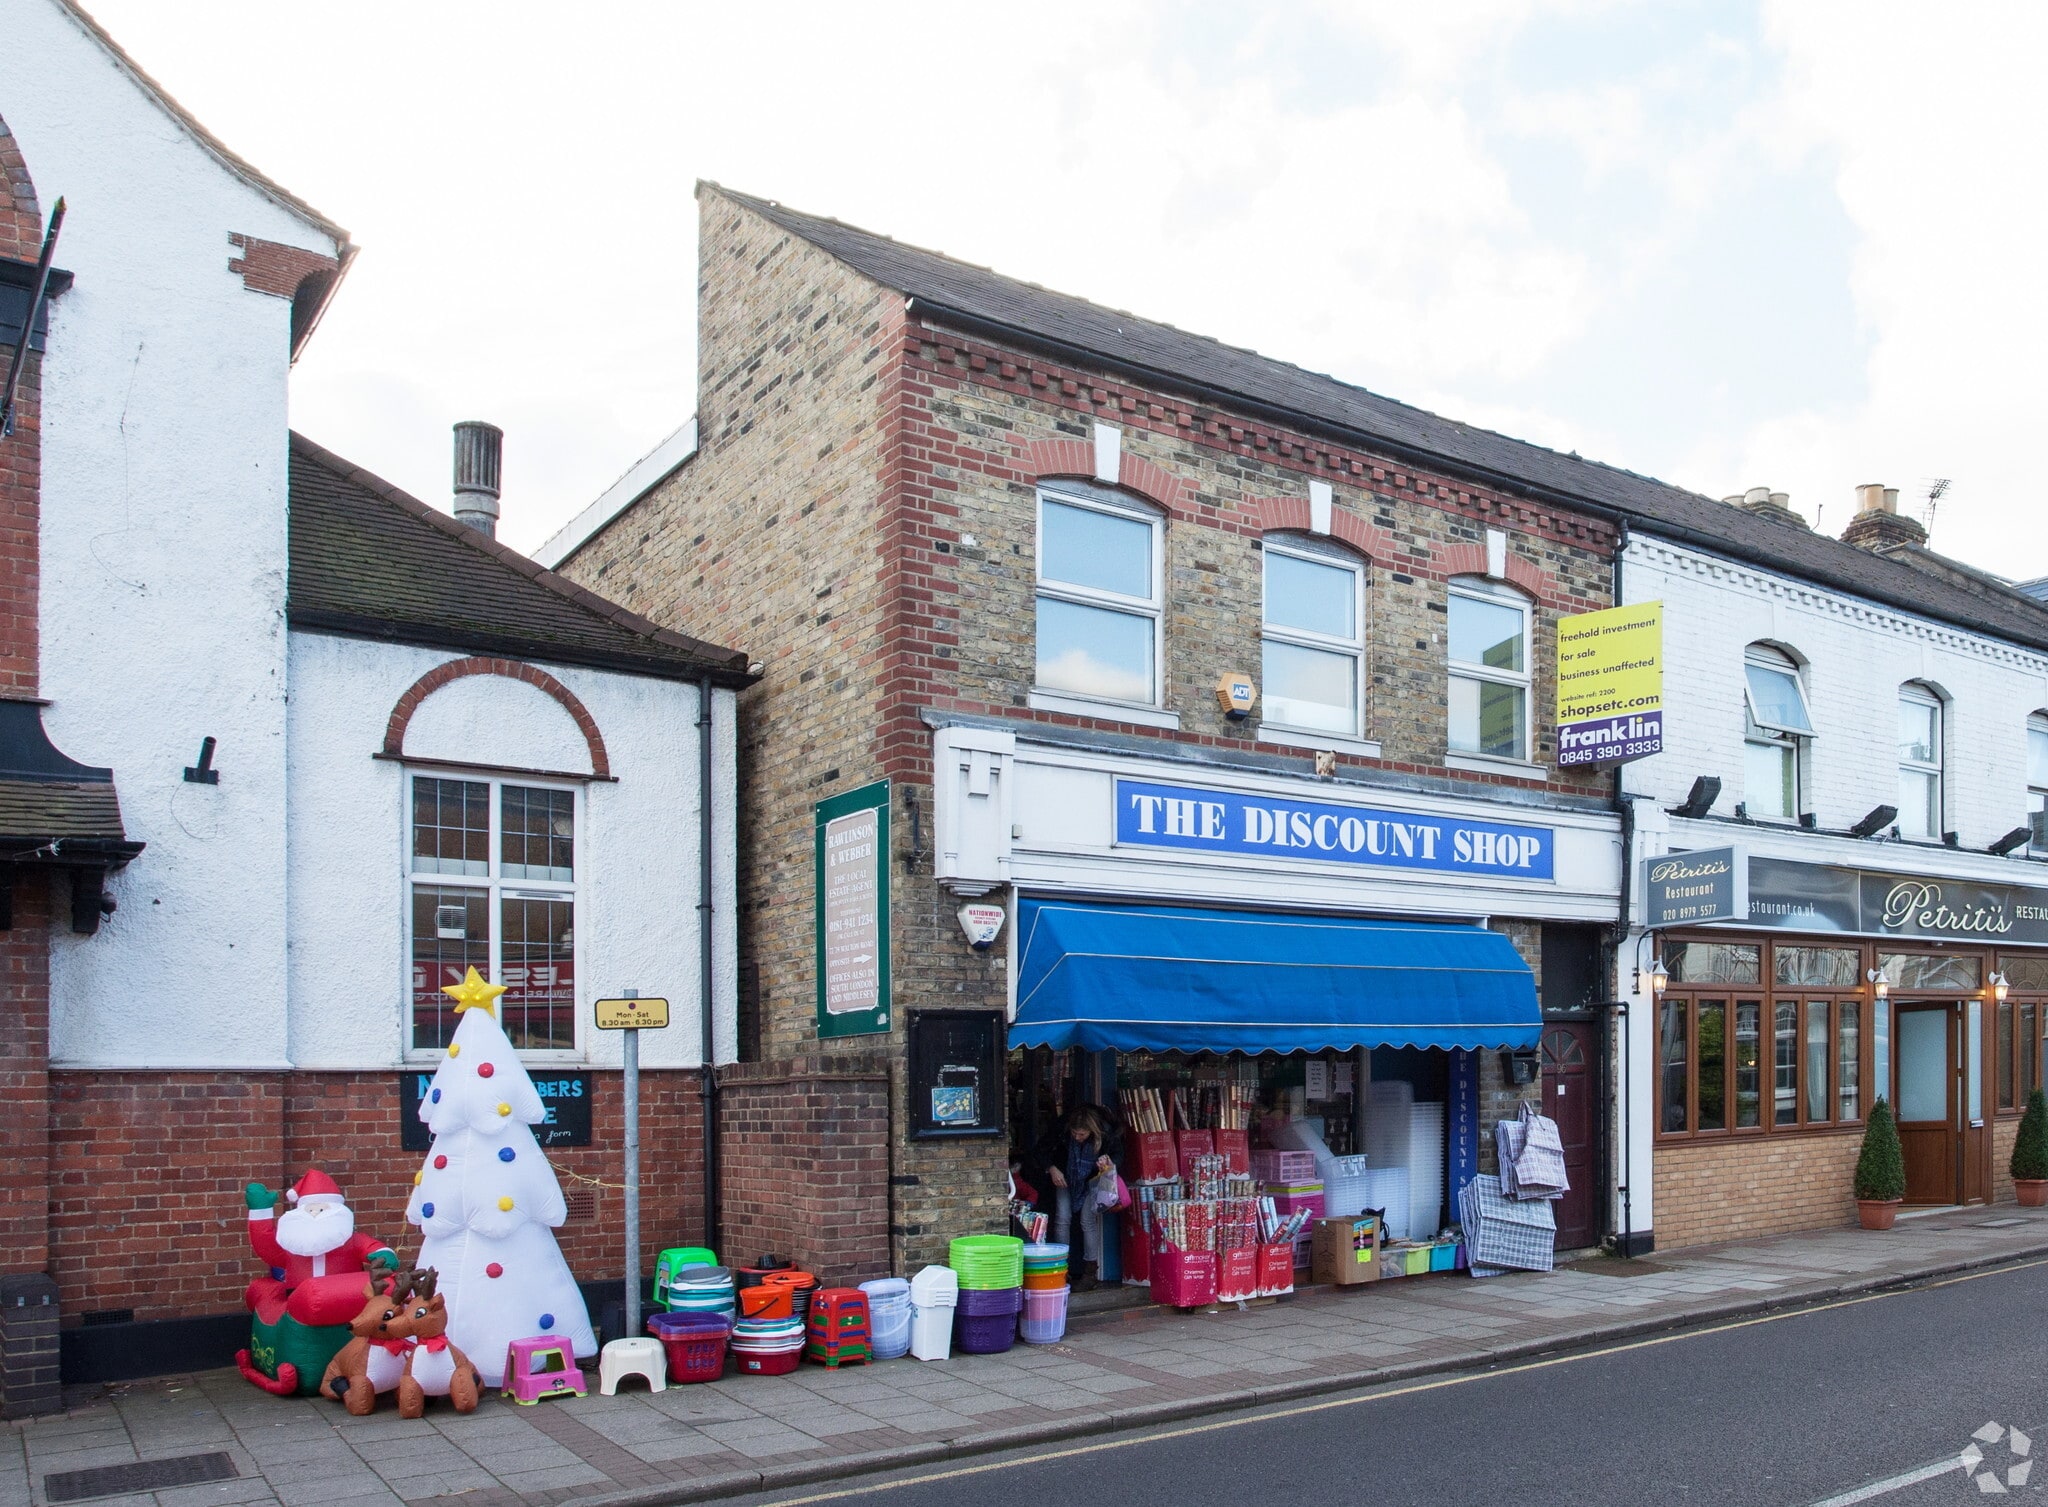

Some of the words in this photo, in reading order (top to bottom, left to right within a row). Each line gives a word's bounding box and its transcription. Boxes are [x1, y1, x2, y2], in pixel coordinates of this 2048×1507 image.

[1560, 627, 1600, 642] freehold
[1602, 618, 1655, 635] investment
[1561, 653, 1573, 662] for
[1577, 648, 1596, 659] sale
[1560, 669, 1600, 681] business
[1602, 656, 1655, 674] unaffected
[1233, 685, 1250, 699] ADT
[1561, 694, 1584, 703] website
[1599, 688, 1616, 696] 2200
[1560, 695, 1659, 718] shopsetc.com
[1560, 716, 1660, 750] franklin
[1560, 749, 1592, 764] 0845
[1596, 745, 1622, 759] 390
[1626, 740, 1660, 755] 3333
[829, 822, 874, 848] RAWLINSON
[1131, 793, 1226, 840] THE
[1243, 805, 1440, 861] DISCOUNT
[1453, 829, 1540, 868] SHOP
[830, 854, 836, 867] &
[838, 842, 872, 864] WEBBER
[1650, 860, 1731, 882] Petriti's
[1665, 882, 1714, 900] Restaurant
[1663, 909, 1676, 920] 020
[1680, 906, 1696, 918] 8979
[1700, 904, 1716, 916] 5577
[1882, 882, 2012, 933] Petriti's
[858, 913, 874, 926] 1234
[546, 1130, 572, 1144] form
